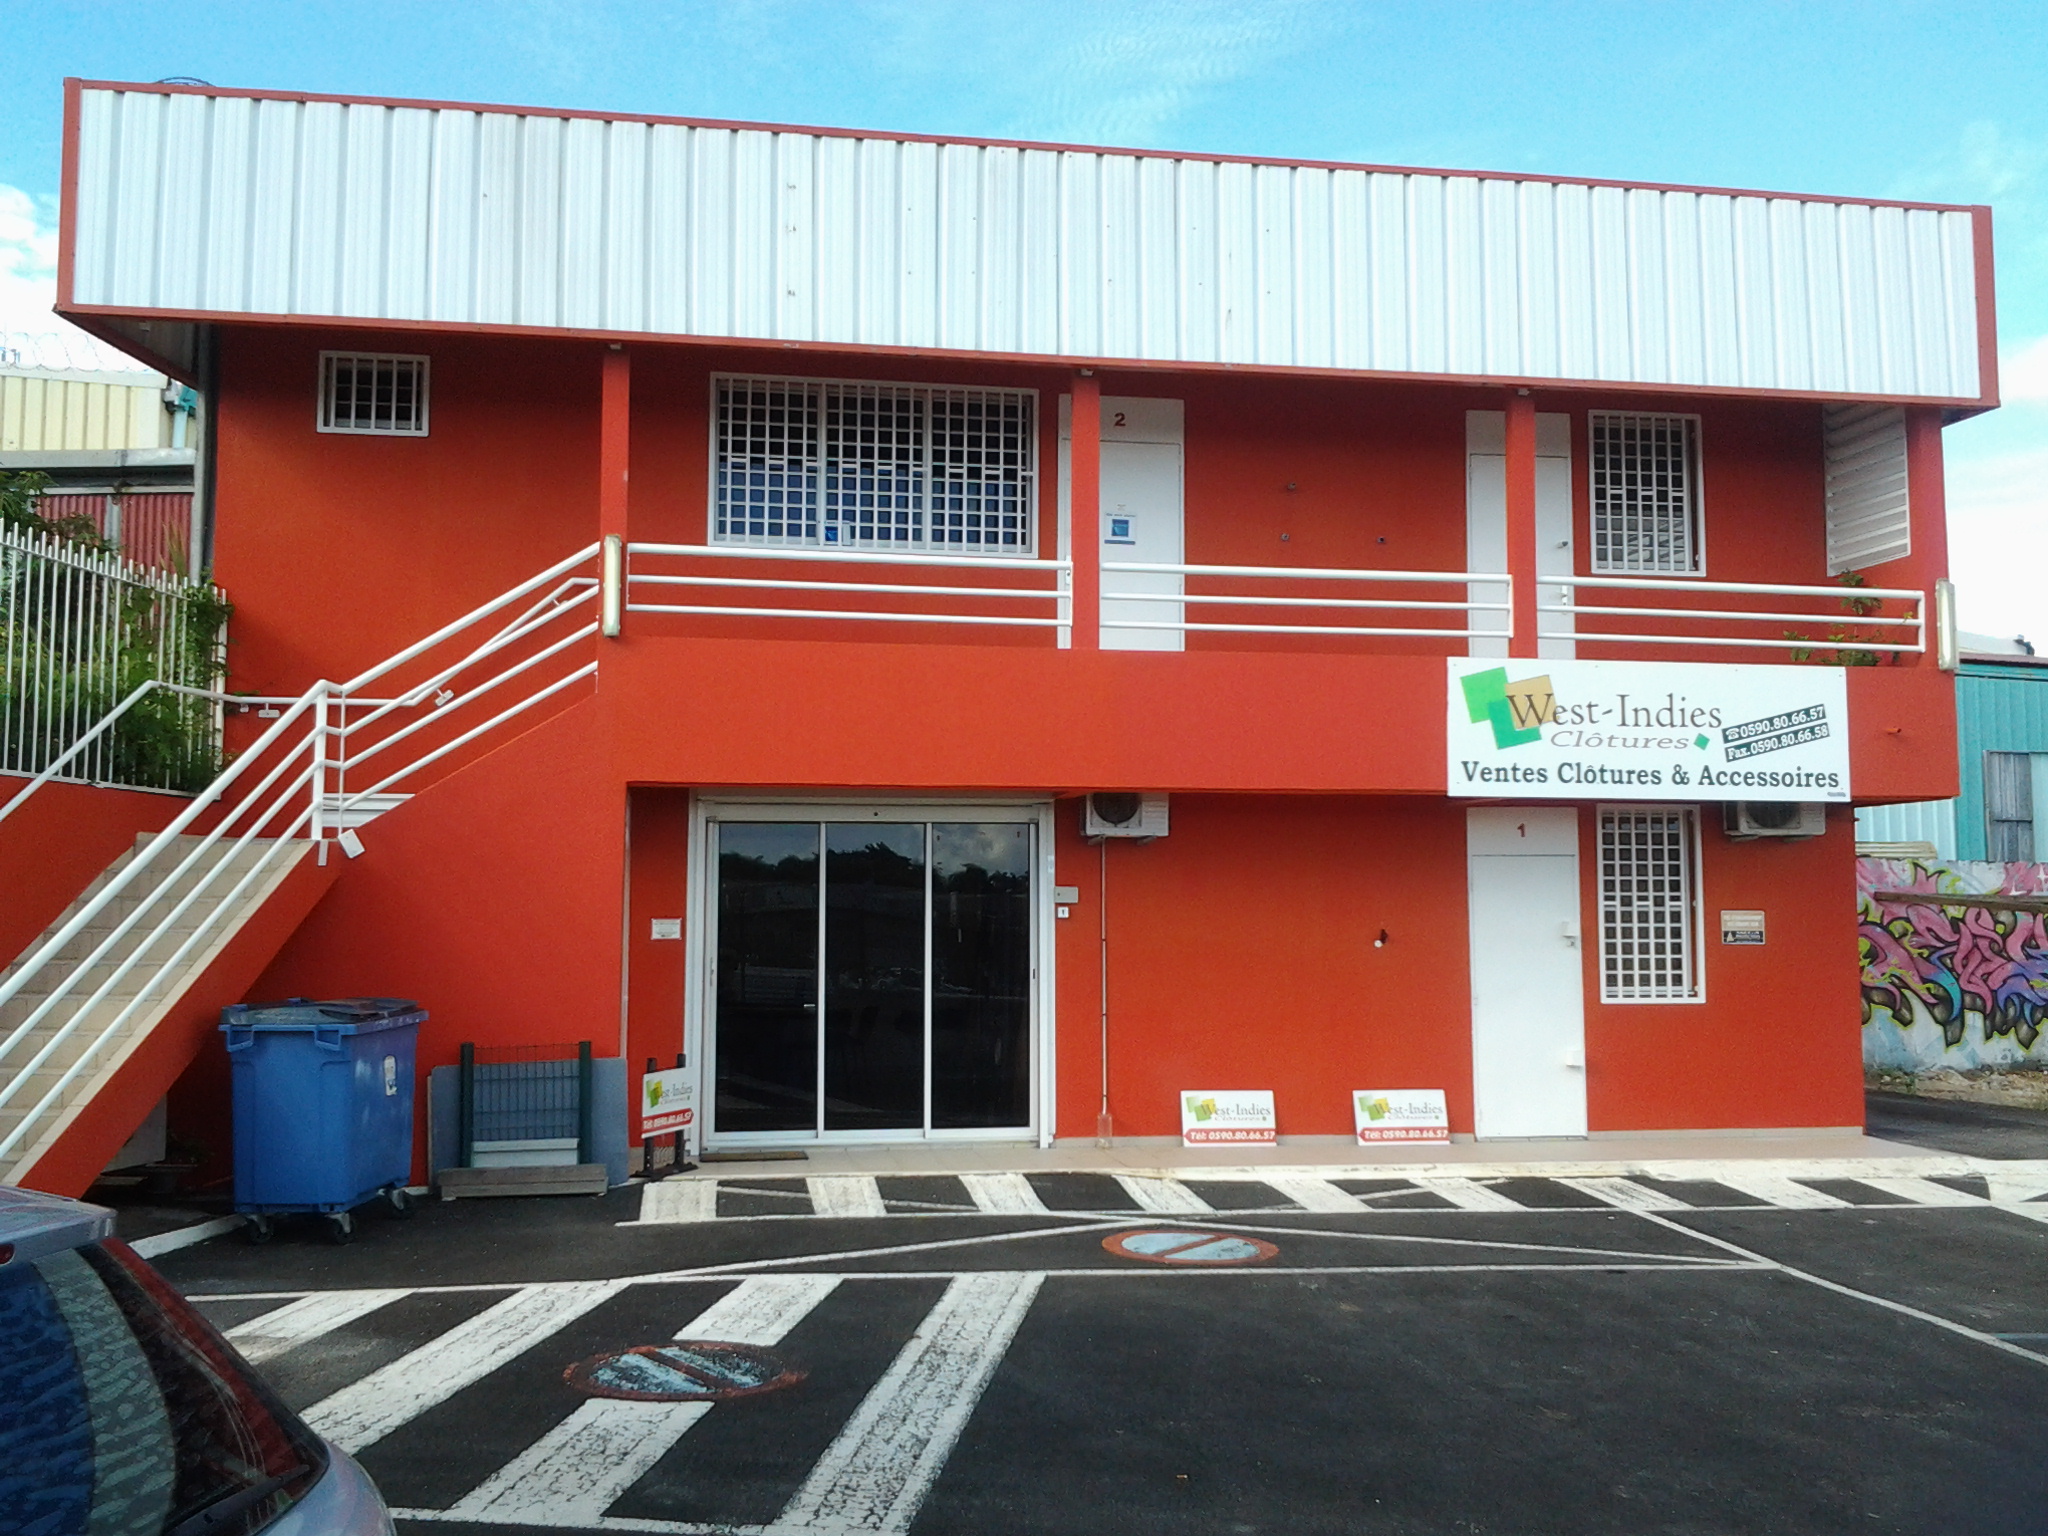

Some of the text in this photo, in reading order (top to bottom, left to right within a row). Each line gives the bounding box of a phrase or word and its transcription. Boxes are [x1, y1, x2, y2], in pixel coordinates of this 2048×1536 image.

[1114, 412, 1126, 427] 2
[1505, 692, 1722, 729] West-Indies
[1740, 706, 1824, 738] 0590.80.66.57
[1550, 730, 1689, 750] Clôtures
[1461, 760, 1839, 788] Ventes Clôtures & Accessoires
[1517, 823, 1526, 838] 1
